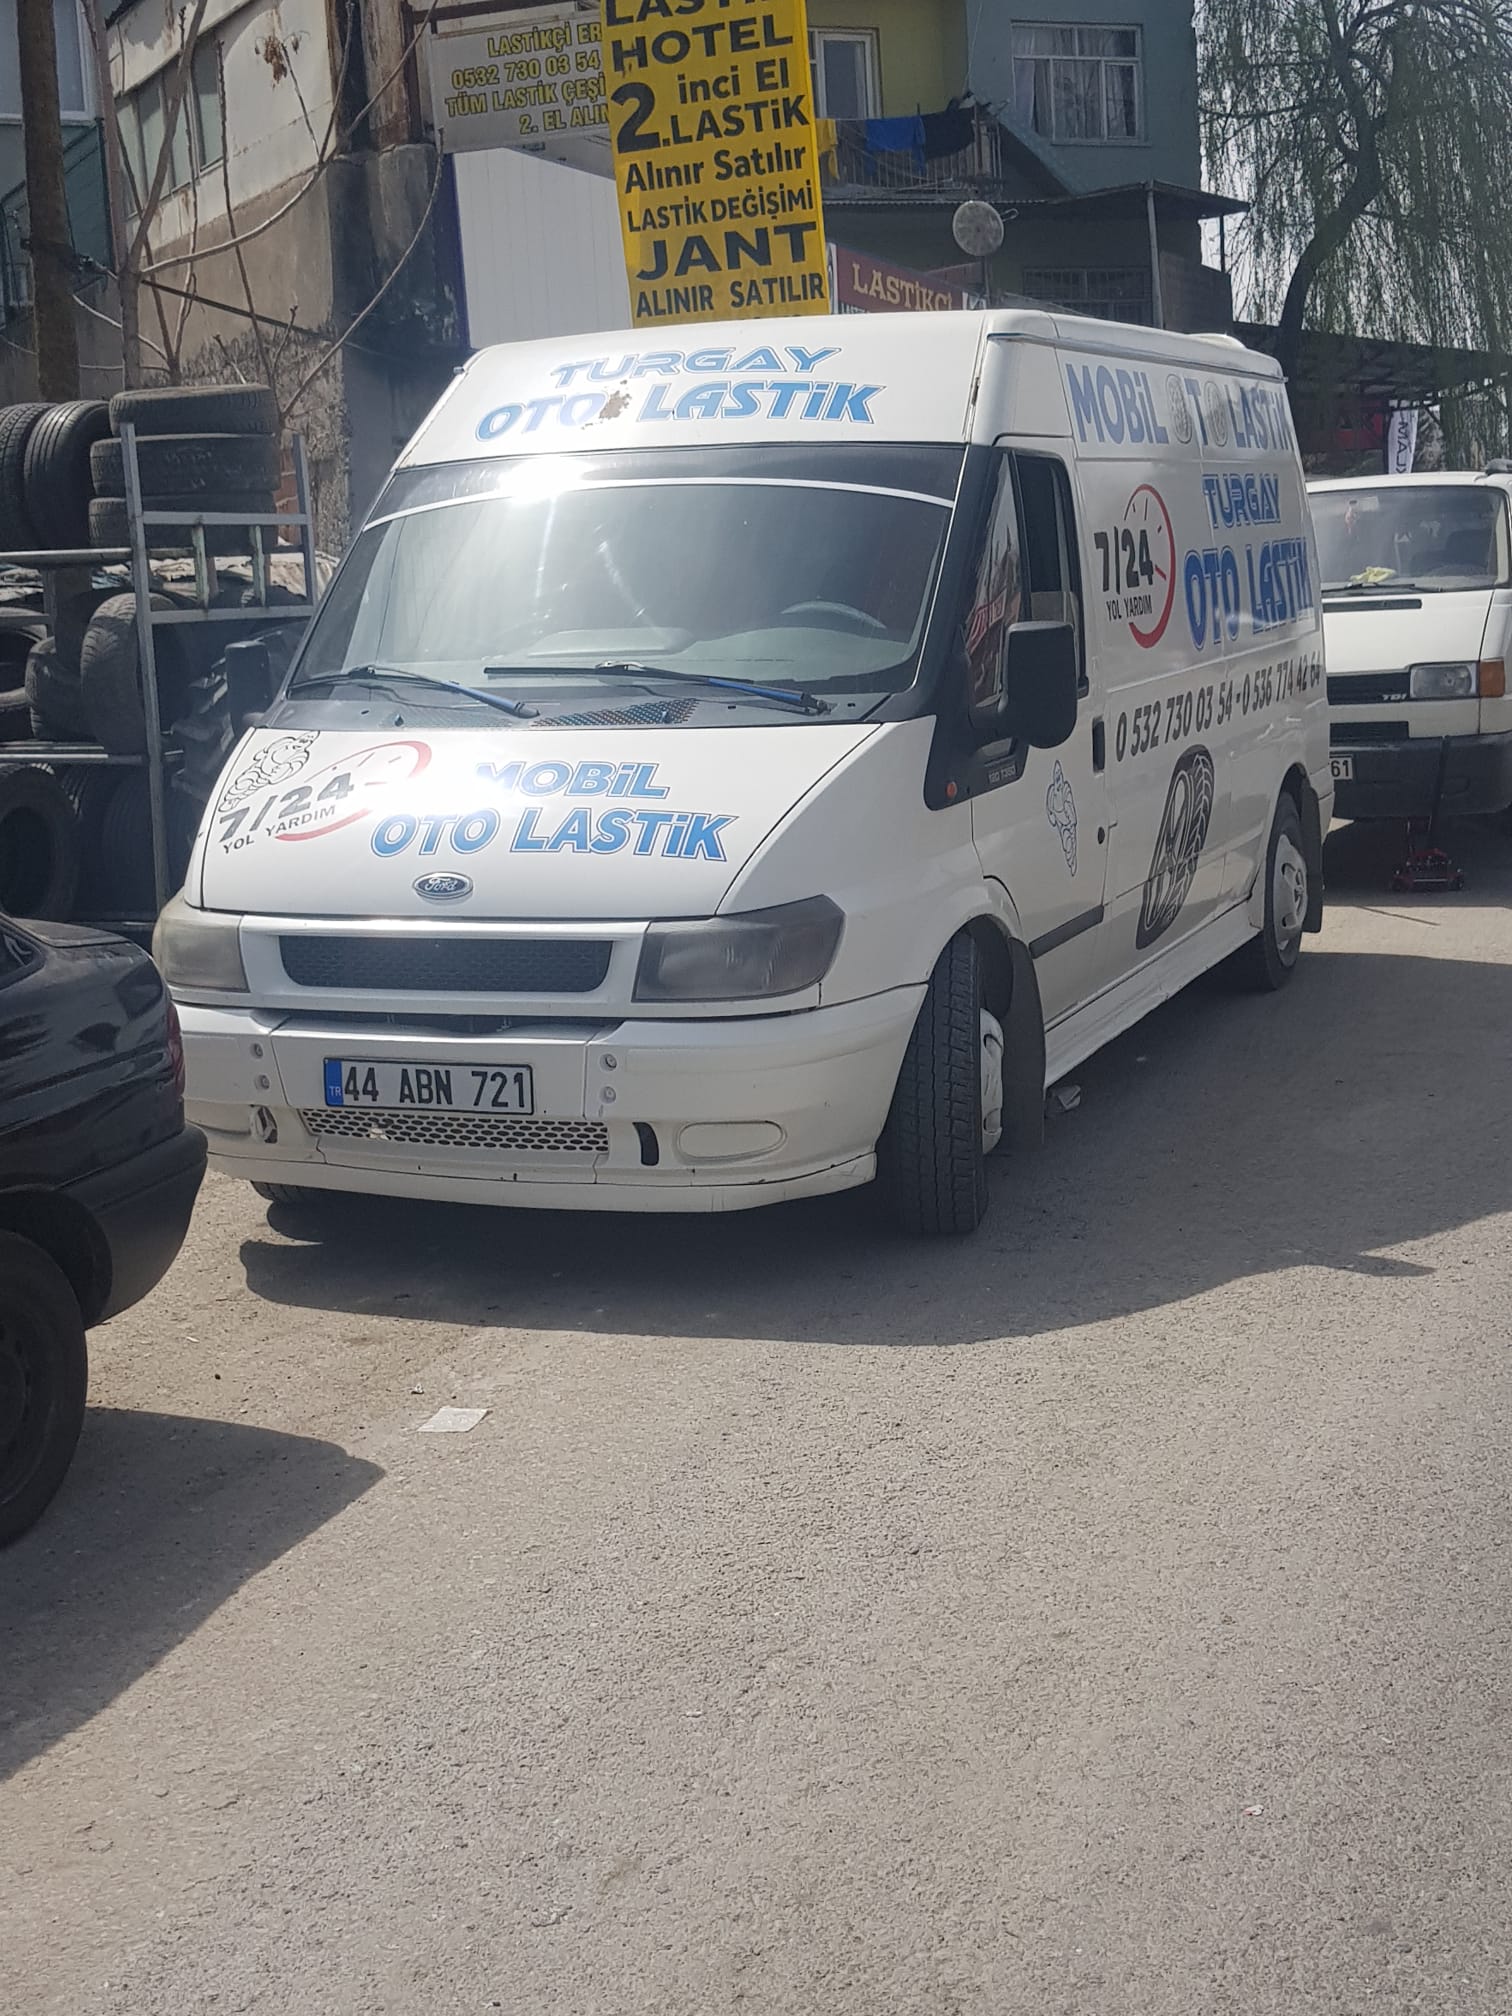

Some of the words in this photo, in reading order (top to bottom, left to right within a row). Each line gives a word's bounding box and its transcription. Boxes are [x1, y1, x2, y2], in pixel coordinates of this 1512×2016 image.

[488, 22, 572, 57] LASTİKÇİ
[611, 14, 793, 72] HOTEL
[452, 65, 499, 90] 0532
[504, 59, 540, 82] 730
[546, 54, 570, 76] 03
[576, 50, 600, 71] 54
[677, 65, 740, 104] inci
[445, 90, 487, 118] TÜM
[493, 80, 556, 111] LASTİK
[520, 114, 539, 135] 2.
[543, 110, 566, 131] EL
[625, 161, 704, 194] Alınır
[714, 142, 806, 181] Satılır
[627, 196, 708, 232] LASTİK
[711, 179, 814, 222] DEĞİŞİMİ
[636, 221, 817, 280] JANT
[636, 285, 714, 318] ALINIR
[730, 272, 825, 308] SATILIR
[550, 345, 842, 388] TURGAY
[475, 391, 608, 442] OTO
[1202, 473, 1281, 529] TURGAY
[1094, 526, 1154, 596] 7/24
[1106, 600, 1122, 622] YOL
[1123, 595, 1153, 618] YARDIM
[1184, 544, 1240, 650] OTO
[1116, 711, 1127, 762] 0
[1131, 700, 1161, 757] 532
[1165, 690, 1193, 744] 730
[1196, 685, 1213, 732] 03
[1252, 666, 1272, 712] 536
[1276, 659, 1293, 703] 774
[1382, 693, 1408, 701] TDI
[1331, 760, 1349, 777] 61
[219, 773, 354, 843] 7/24
[223, 838, 254, 854] YOL
[266, 805, 335, 837] YARDIM
[370, 808, 501, 858] OTO
[329, 1085, 342, 1097] TR
[344, 1066, 379, 1102] 44
[400, 1068, 453, 1105] ABN
[471, 1070, 525, 1108] 721
